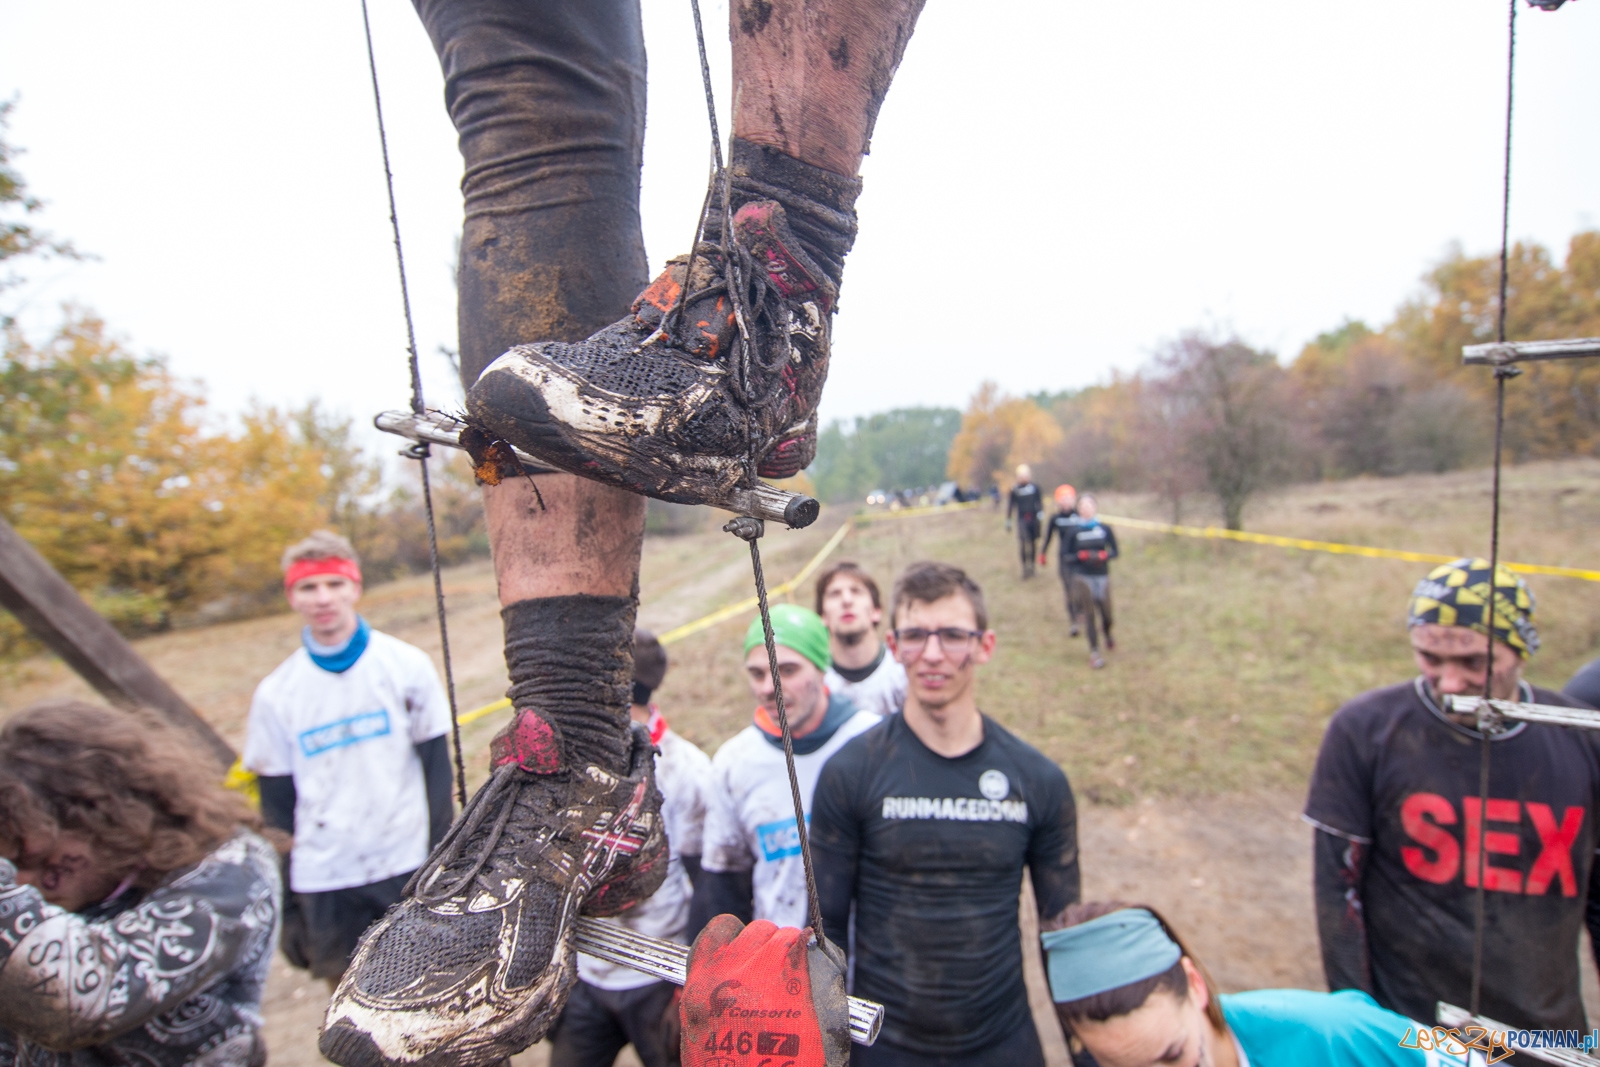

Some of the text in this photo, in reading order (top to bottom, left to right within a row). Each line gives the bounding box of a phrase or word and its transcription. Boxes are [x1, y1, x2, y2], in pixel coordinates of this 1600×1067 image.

[1401, 792, 1585, 897] SEX
[729, 1006, 802, 1019] Consorte
[704, 1031, 788, 1055] 446 7
